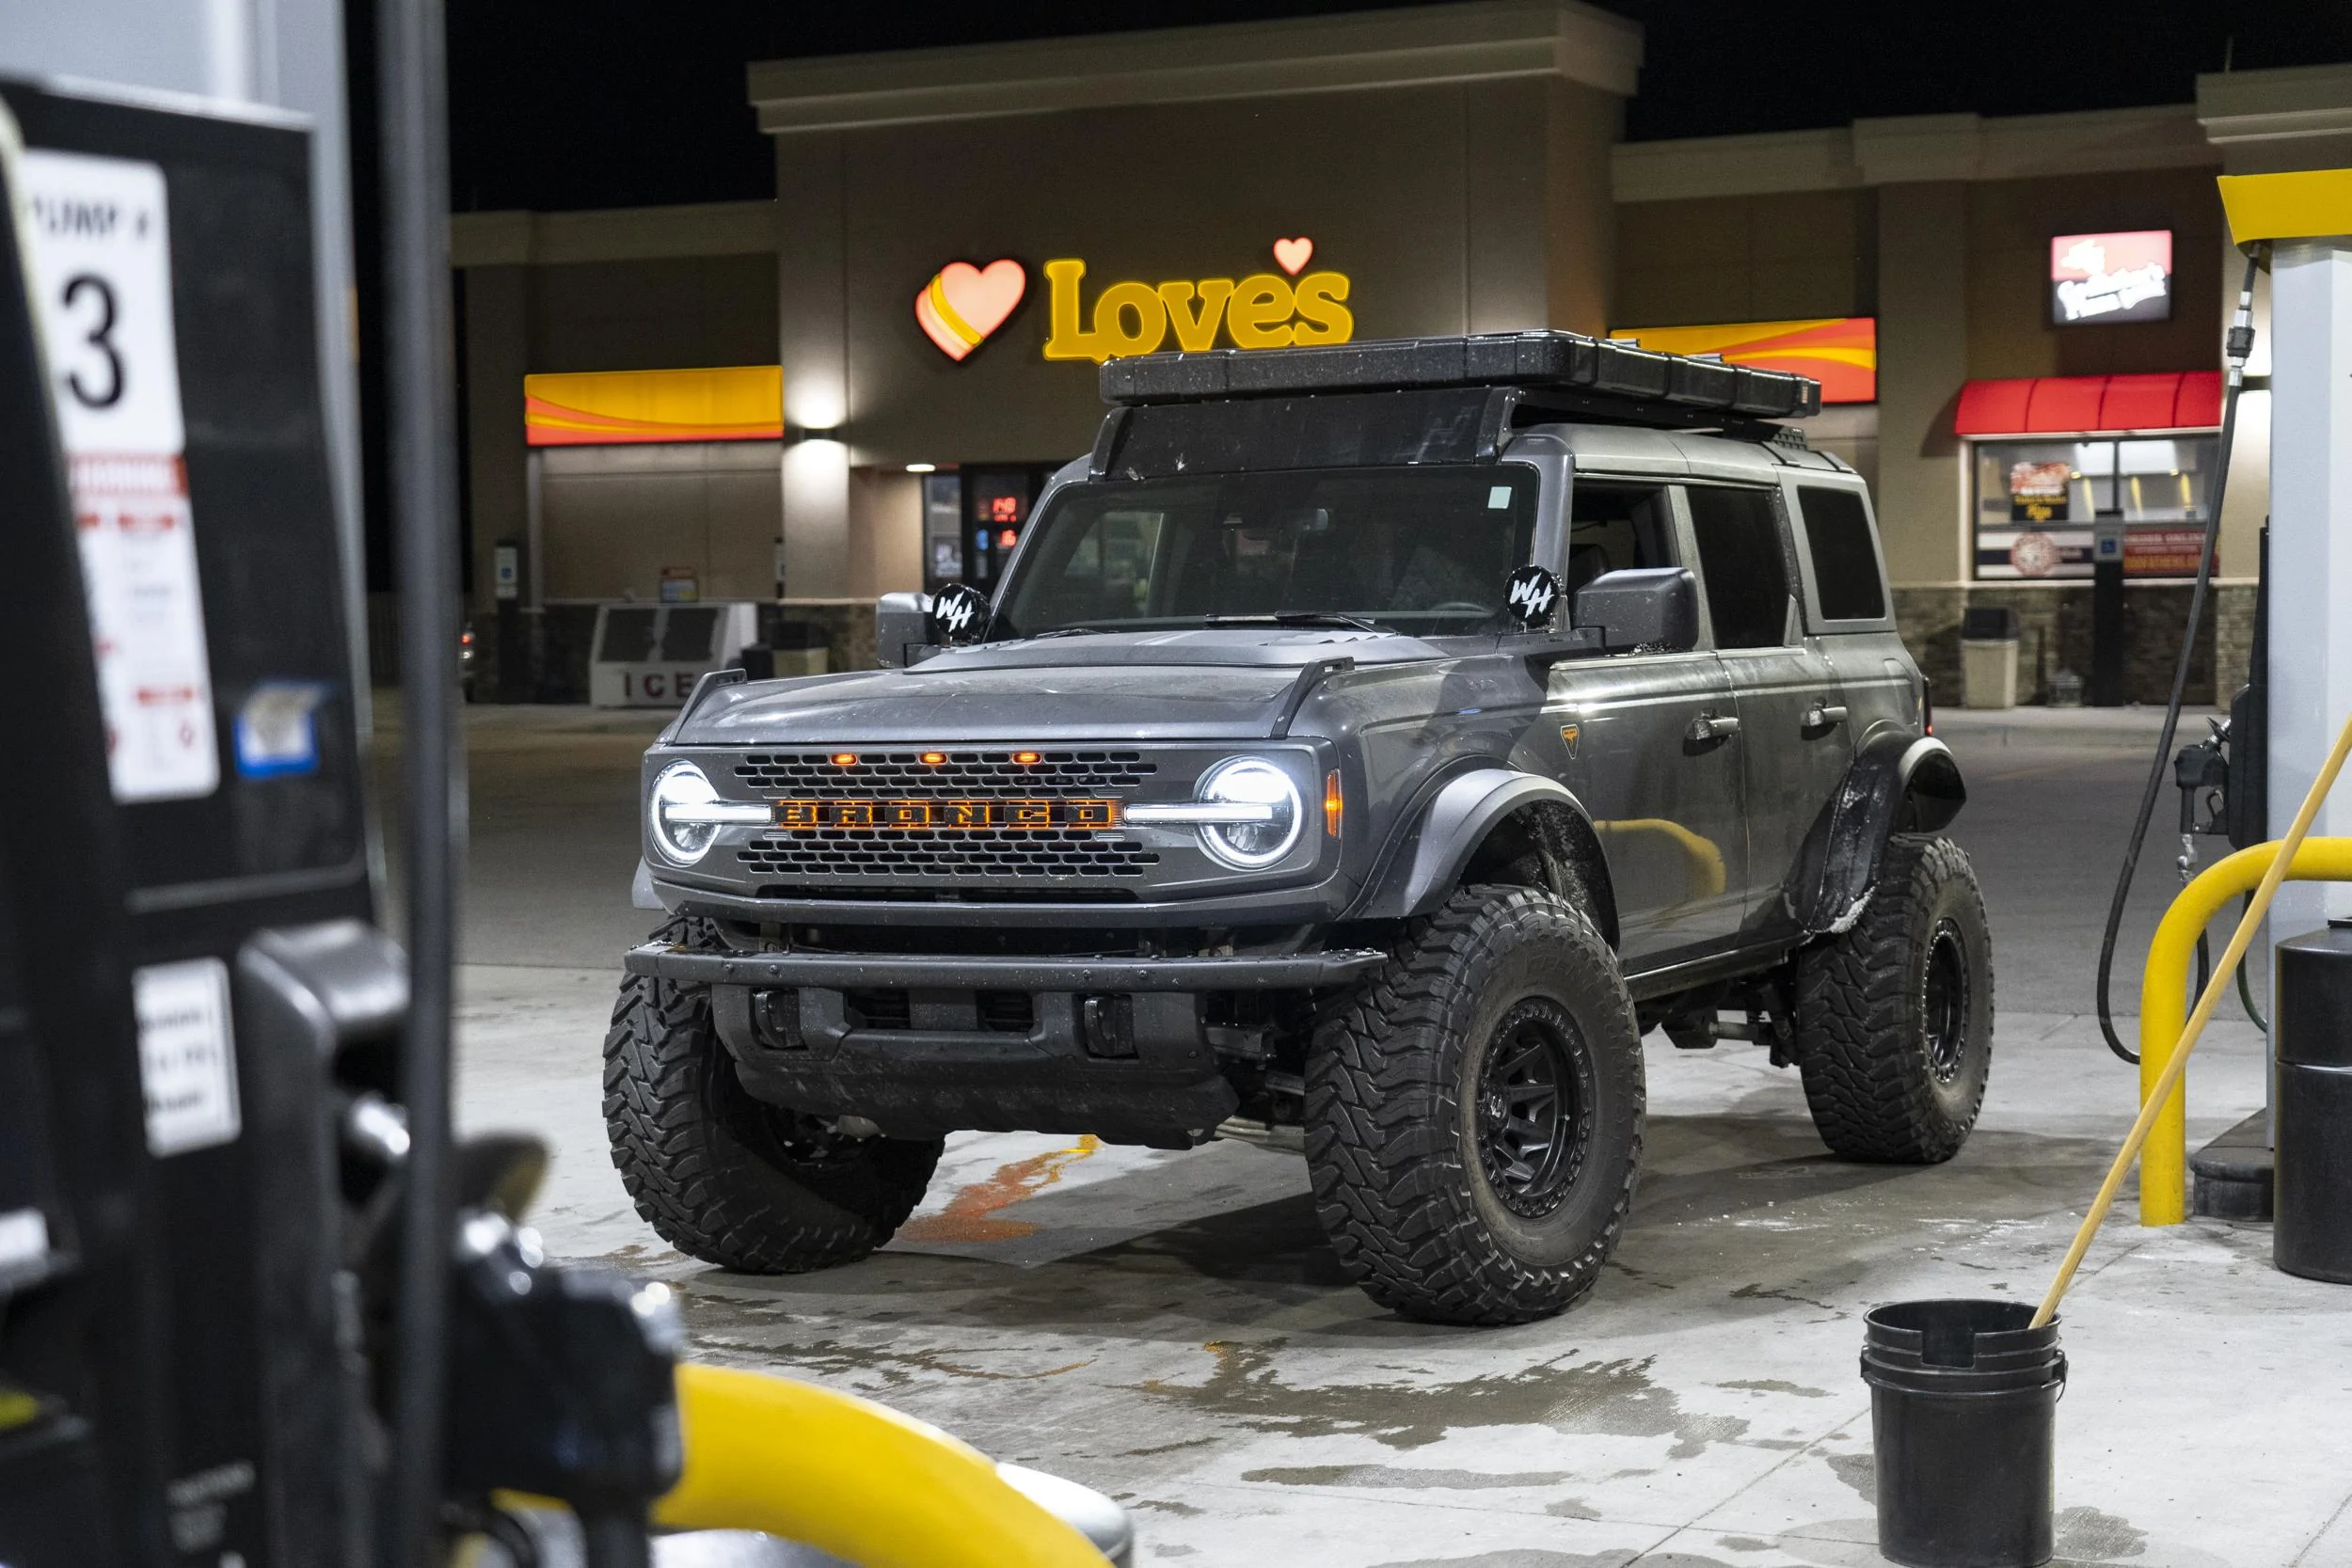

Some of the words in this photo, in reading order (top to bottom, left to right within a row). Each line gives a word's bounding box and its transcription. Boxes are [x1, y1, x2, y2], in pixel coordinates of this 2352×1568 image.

[60, 272, 123, 410] 3
[936, 591, 975, 633] WH
[1509, 572, 1555, 619] WH
[625, 672, 694, 698] ICE
[775, 800, 1114, 829] BRONCO
